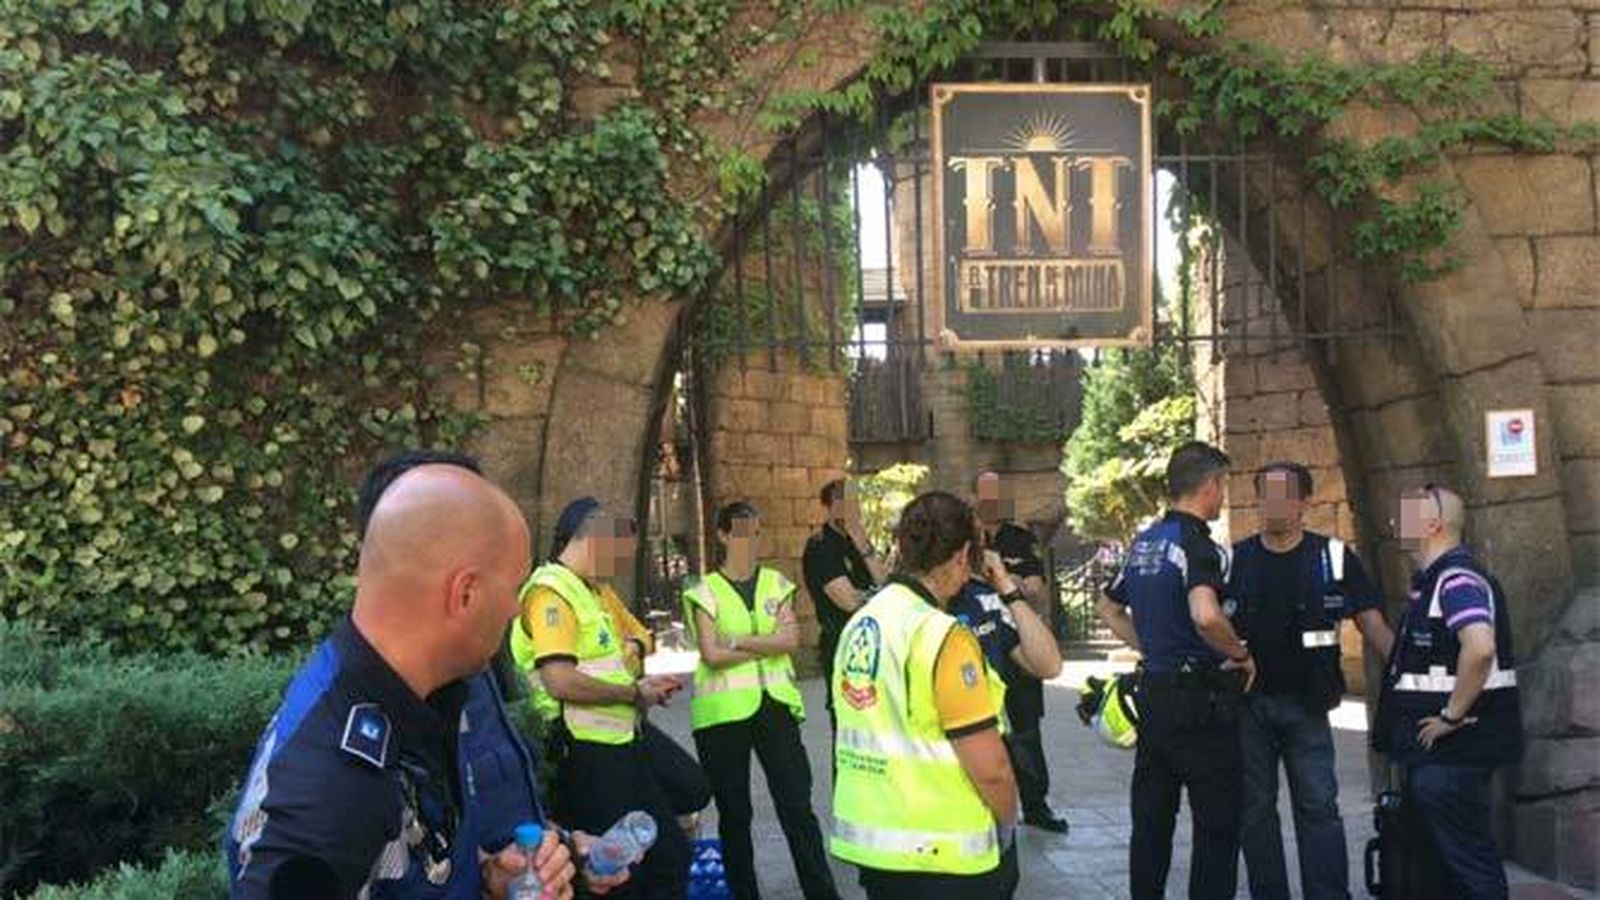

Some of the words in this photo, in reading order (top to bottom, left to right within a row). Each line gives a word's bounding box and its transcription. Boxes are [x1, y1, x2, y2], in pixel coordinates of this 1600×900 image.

[948, 156, 1136, 257] TNT
[985, 264, 1040, 308] TREN
[1064, 264, 1122, 308] MINA
